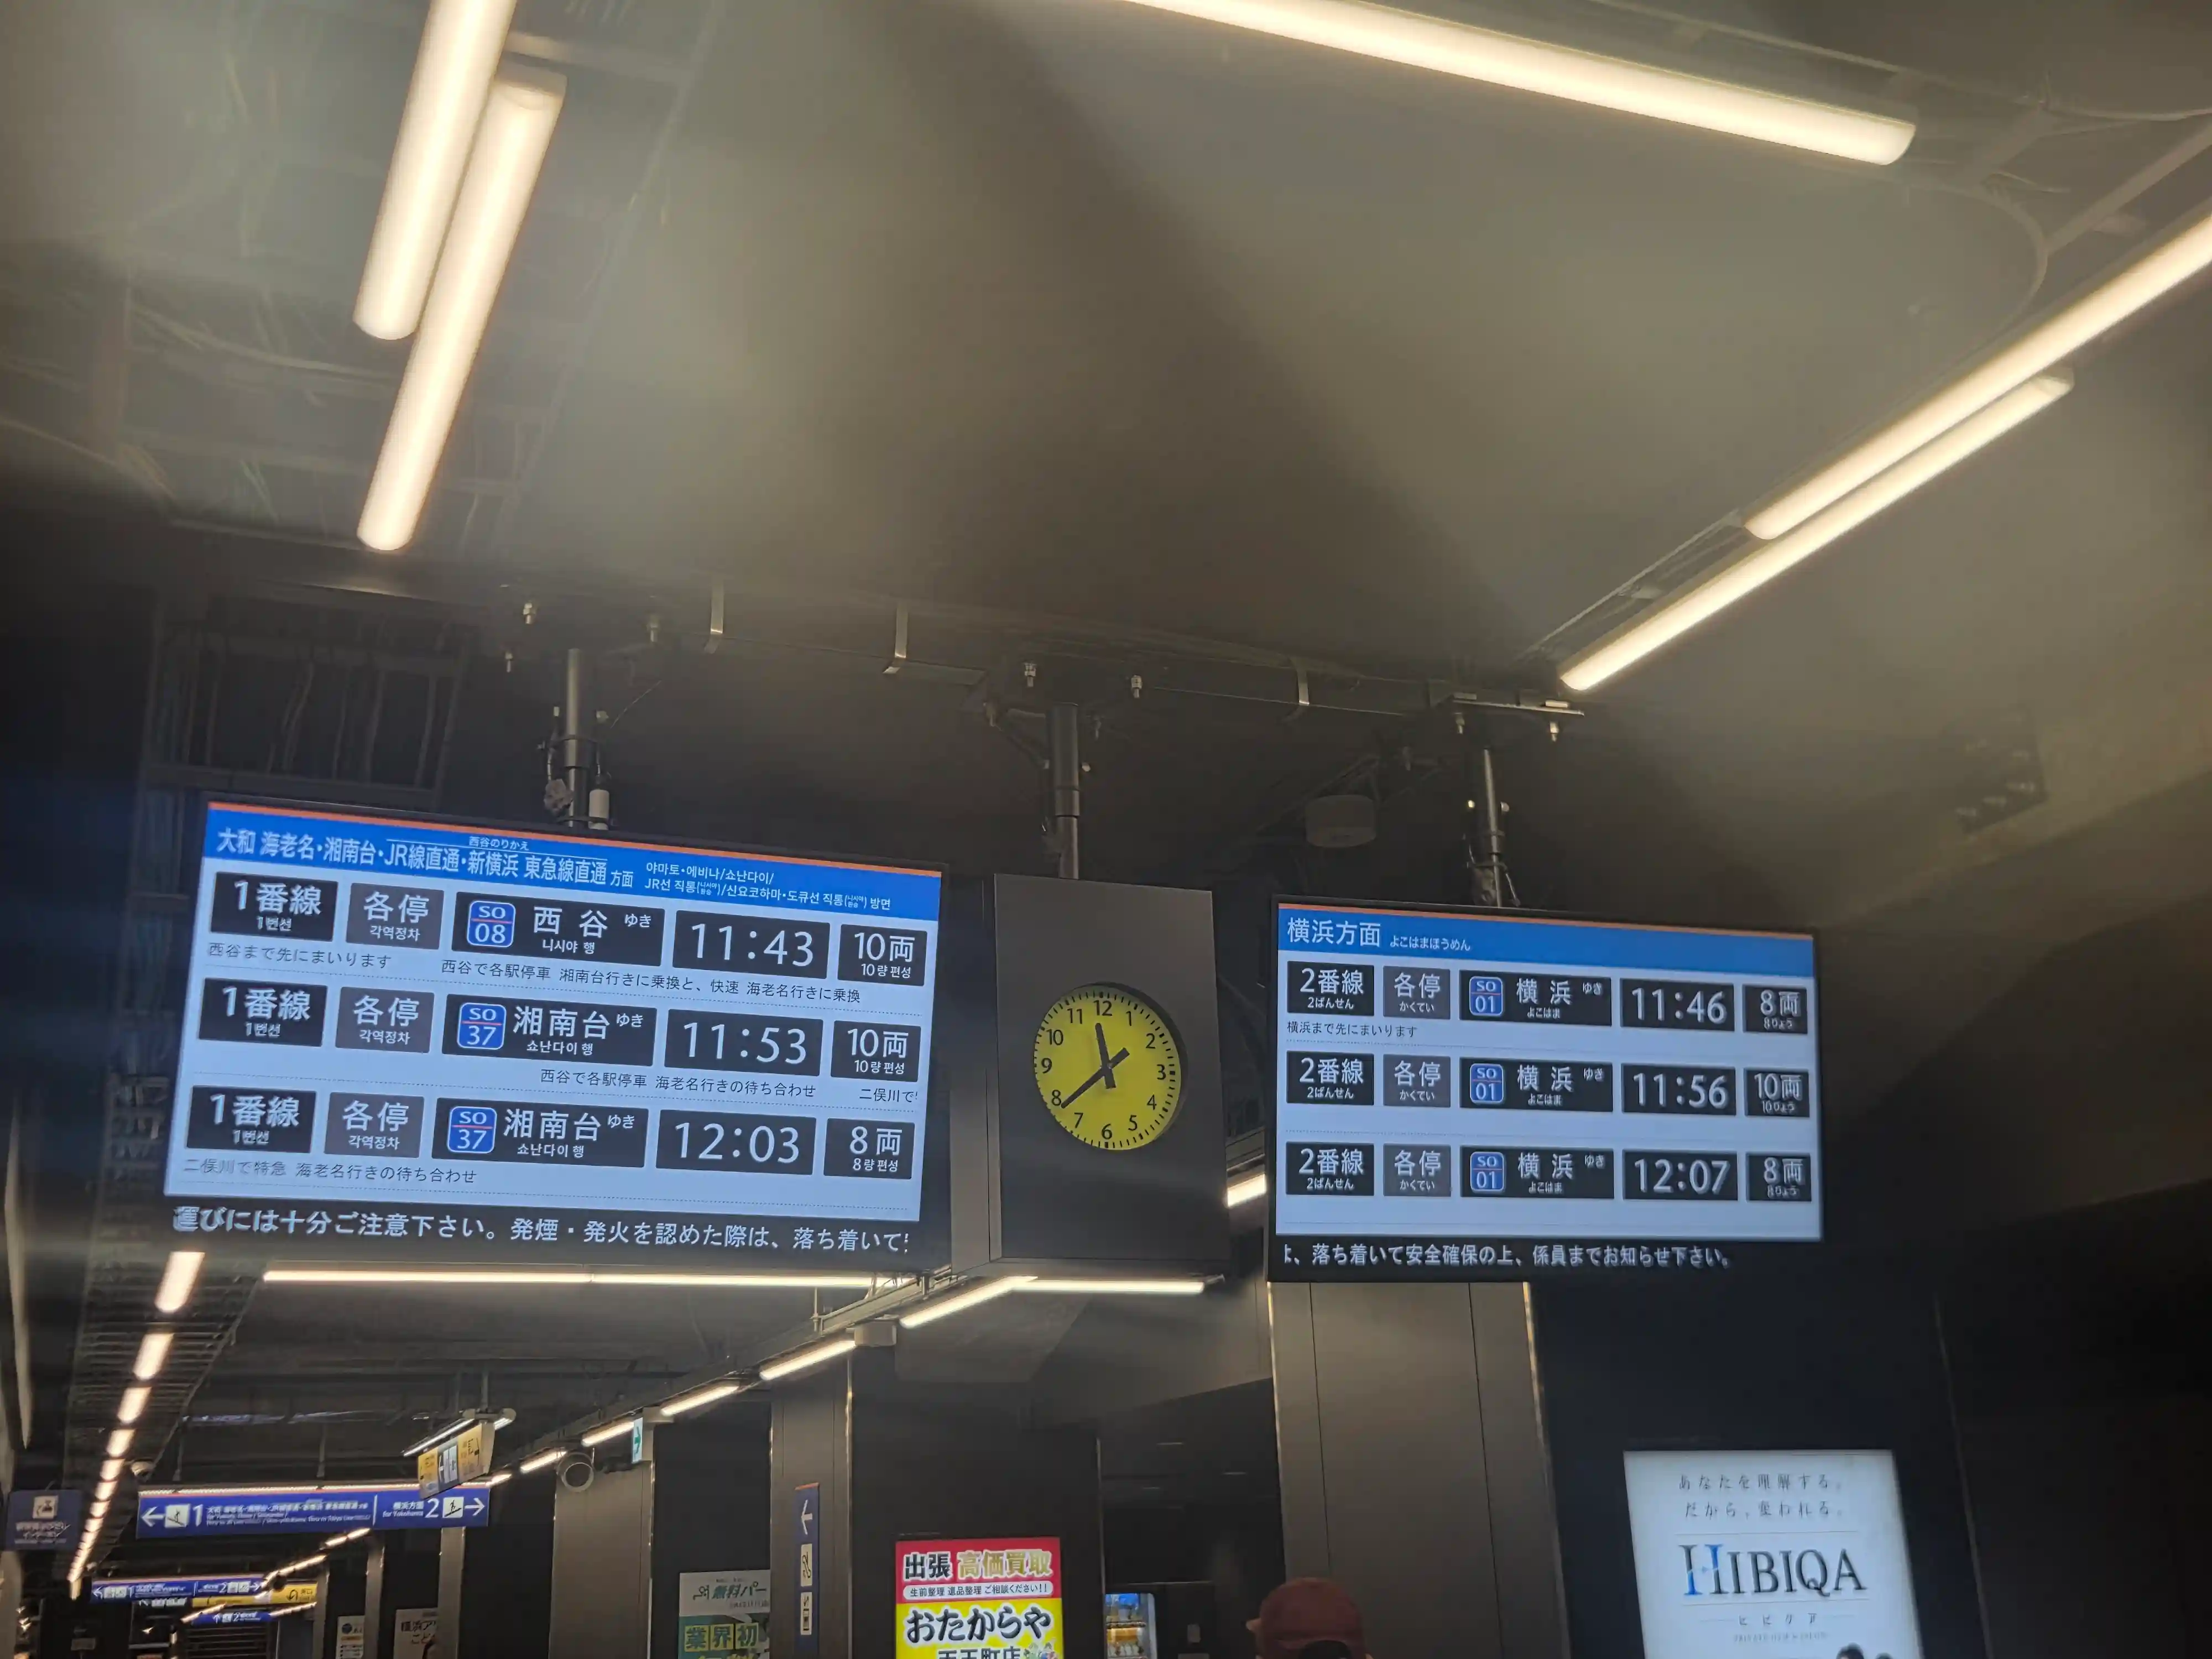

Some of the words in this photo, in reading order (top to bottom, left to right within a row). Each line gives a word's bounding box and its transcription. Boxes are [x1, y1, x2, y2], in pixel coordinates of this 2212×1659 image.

[469, 836, 529, 851] 西谷のりかえ
[216, 827, 256, 854] 大和
[524, 855, 607, 885] 東急線直通
[610, 870, 634, 888] 方面
[234, 880, 322, 916] 1番線
[644, 878, 670, 891] JR선
[870, 897, 891, 911] 방면
[363, 891, 430, 924] 各停
[479, 906, 505, 919] SO
[257, 916, 293, 933] 1번선
[624, 913, 651, 928] ゆき
[370, 925, 420, 942] 각역정차
[475, 924, 505, 944] 08
[1287, 916, 1381, 948] 横浜方面
[1390, 935, 1471, 952] よこはまほうめん
[542, 939, 578, 953] 니시야
[583, 942, 596, 954] 행
[691, 923, 813, 967] 11:43
[854, 932, 915, 962] 10両
[208, 942, 392, 969] 西谷まで先にまいります
[442, 959, 551, 979] 西谷で各駅停車
[747, 981, 861, 1003] 海老名行きに乗換
[1300, 967, 1364, 995] 2番線
[1394, 972, 1441, 999] 各停
[1476, 981, 1496, 992] SO
[1516, 978, 1572, 1005] 横浜
[1583, 982, 1603, 995] ゆき
[222, 986, 311, 1021] 1番線
[353, 995, 420, 1026] 各停
[1094, 1000, 1112, 1017] 12
[1307, 996, 1354, 1010] 2ばんせん
[1399, 1001, 1434, 1013] かくてい
[1475, 996, 1496, 1013] 01
[1527, 1006, 1561, 1019] よこはま
[1632, 987, 1727, 1025] 11:46
[1760, 989, 1802, 1018] 8両
[469, 1008, 497, 1021] SO
[513, 1006, 611, 1040] 湘南台
[615, 1013, 644, 1028] ゆき
[1067, 1008, 1083, 1024] 11
[1126, 1010, 1132, 1026] 1
[245, 1022, 281, 1038] 1번선
[359, 1029, 411, 1045] 각역정차
[467, 1026, 497, 1046] 37
[1046, 1028, 1064, 1046] 10
[1287, 1021, 1417, 1039] 横浜まで先にまいります
[526, 1040, 577, 1055] 쇼난다이
[581, 1043, 593, 1056] 행
[684, 1021, 806, 1065] 11:53
[848, 1028, 910, 1058] 10両
[1145, 1032, 1156, 1050] 2
[1041, 1057, 1052, 1074] 9
[1156, 1064, 1166, 1081] 3
[1299, 1057, 1364, 1084] 2番線
[1394, 1060, 1441, 1087] 各停
[1477, 1068, 1497, 1079] SO
[541, 1069, 647, 1088] 西谷で各駅停車
[655, 1075, 817, 1098] 海老名行きの待ち合わせ
[860, 1087, 919, 1103] 二俣川で
[1517, 1064, 1574, 1092] 横浜
[1583, 1067, 1604, 1082] ゆき
[1754, 1073, 1803, 1101] 10両
[1051, 1089, 1062, 1107] 8
[1307, 1086, 1354, 1099] 2ばんせん
[1399, 1089, 1435, 1102] かくてい
[1475, 1083, 1497, 1101] 01
[1527, 1093, 1563, 1106] よこはま
[1633, 1072, 1729, 1109] 11:56
[210, 1094, 300, 1128] 1番線
[1146, 1094, 1157, 1110] 4
[342, 1100, 410, 1132] 各停
[459, 1111, 487, 1125] SO
[503, 1108, 602, 1141] 湘南台
[607, 1114, 635, 1129] ゆき
[1074, 1112, 1084, 1129] 7
[1128, 1114, 1138, 1131] 5
[233, 1130, 270, 1145] 1번선
[457, 1129, 487, 1150] 37
[849, 1126, 903, 1157] 8両
[1101, 1123, 1113, 1140] 6
[348, 1135, 400, 1150] 각역정차
[517, 1144, 568, 1158] 쇼난다이
[572, 1145, 585, 1158] 행
[675, 1121, 800, 1164] 12:03
[182, 1159, 286, 1177] 二俣川で特急
[296, 1162, 478, 1184] 海老名行きの待ち合わせ
[1298, 1147, 1364, 1176] 2番線
[1394, 1149, 1441, 1177] 各停
[1477, 1156, 1498, 1168] SO
[1517, 1152, 1574, 1180] 横浜
[1584, 1154, 1605, 1168] ゆき
[1764, 1157, 1804, 1185] 8両
[1306, 1177, 1354, 1190] 2ばんせん
[1399, 1178, 1435, 1191] かくてい
[1476, 1171, 1498, 1190] 01
[1634, 1158, 1731, 1194] 12:07
[1528, 1181, 1563, 1194] よこはま
[172, 1205, 909, 1255] 運びには十分ご注意下さい。発煙・発火を認めた際は、落ち着いて
[193, 1504, 203, 1527] 1
[425, 1498, 440, 1518] 2
[905, 1552, 951, 1580] 出張
[957, 1550, 1051, 1578] 高価買取
[1678, 1543, 1867, 1597] HIBIQA
[906, 1605, 1051, 1642] おたからや
